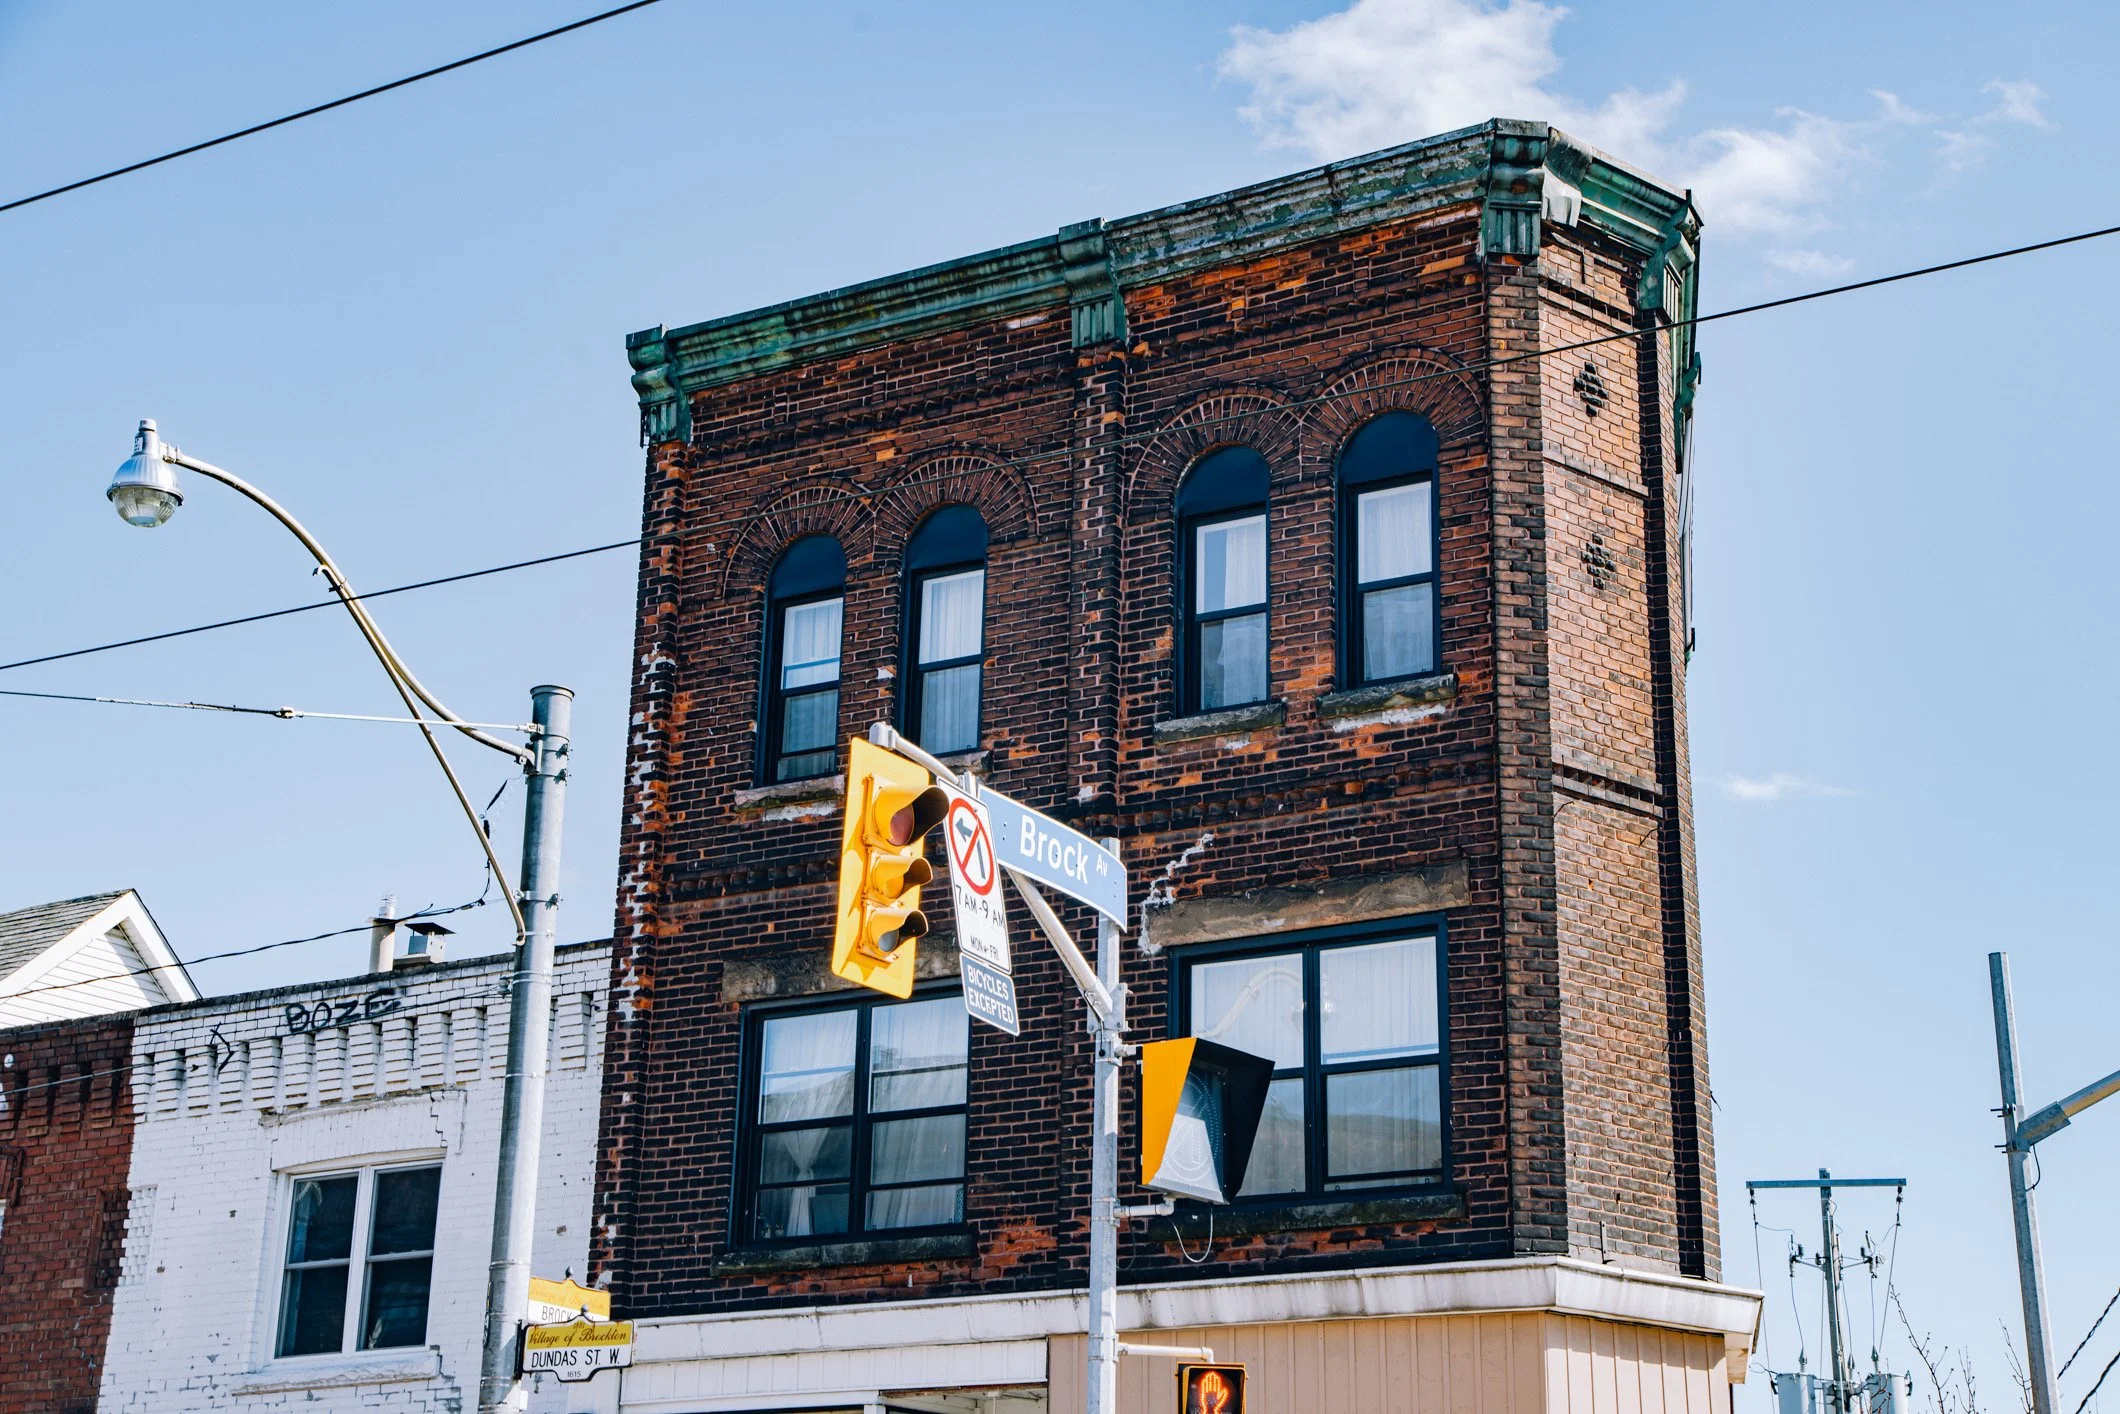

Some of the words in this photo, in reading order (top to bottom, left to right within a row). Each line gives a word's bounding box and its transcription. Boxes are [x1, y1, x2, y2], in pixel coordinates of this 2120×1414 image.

[1020, 814, 1089, 885] Brock
[1096, 853, 1108, 877] Av
[956, 884, 962, 906] 7
[992, 909, 1005, 928] AM
[970, 934, 984, 954] MON
[989, 944, 999, 961] FRI
[967, 964, 1009, 1001] BICYCLES
[968, 986, 1014, 1025] EXCEPTED
[529, 1332, 560, 1348] Village
[563, 1333, 575, 1347] of
[579, 1327, 627, 1342] Brockton
[531, 1350, 578, 1368] DUNDAS
[584, 1348, 601, 1366] ST.
[609, 1348, 620, 1365] W.
